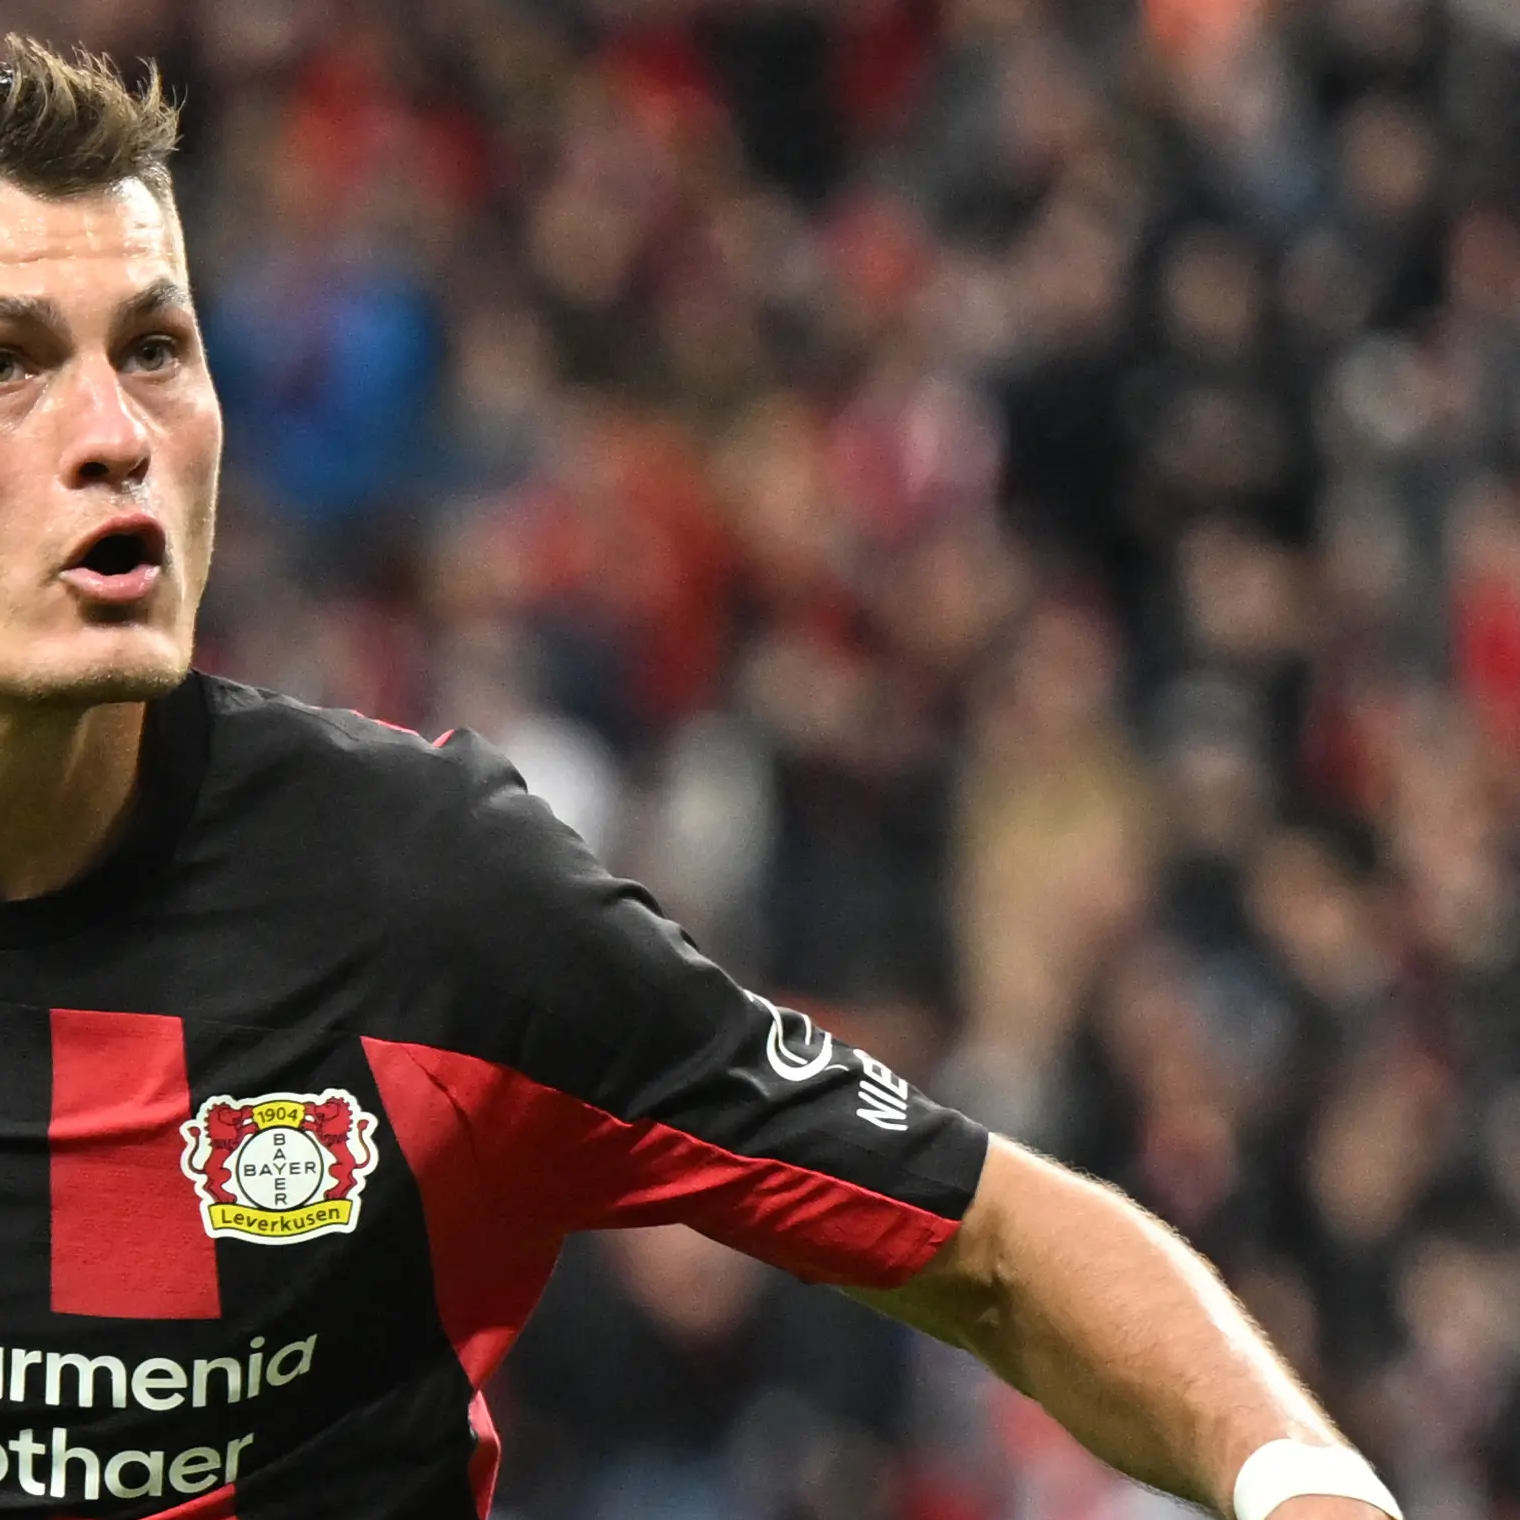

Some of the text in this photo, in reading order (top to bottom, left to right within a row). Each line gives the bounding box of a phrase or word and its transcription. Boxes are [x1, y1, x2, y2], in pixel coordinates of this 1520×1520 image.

[257, 1106, 298, 1124] 1904
[243, 1161, 317, 1177] BAYER
[220, 1207, 341, 1233] Leverkusen
